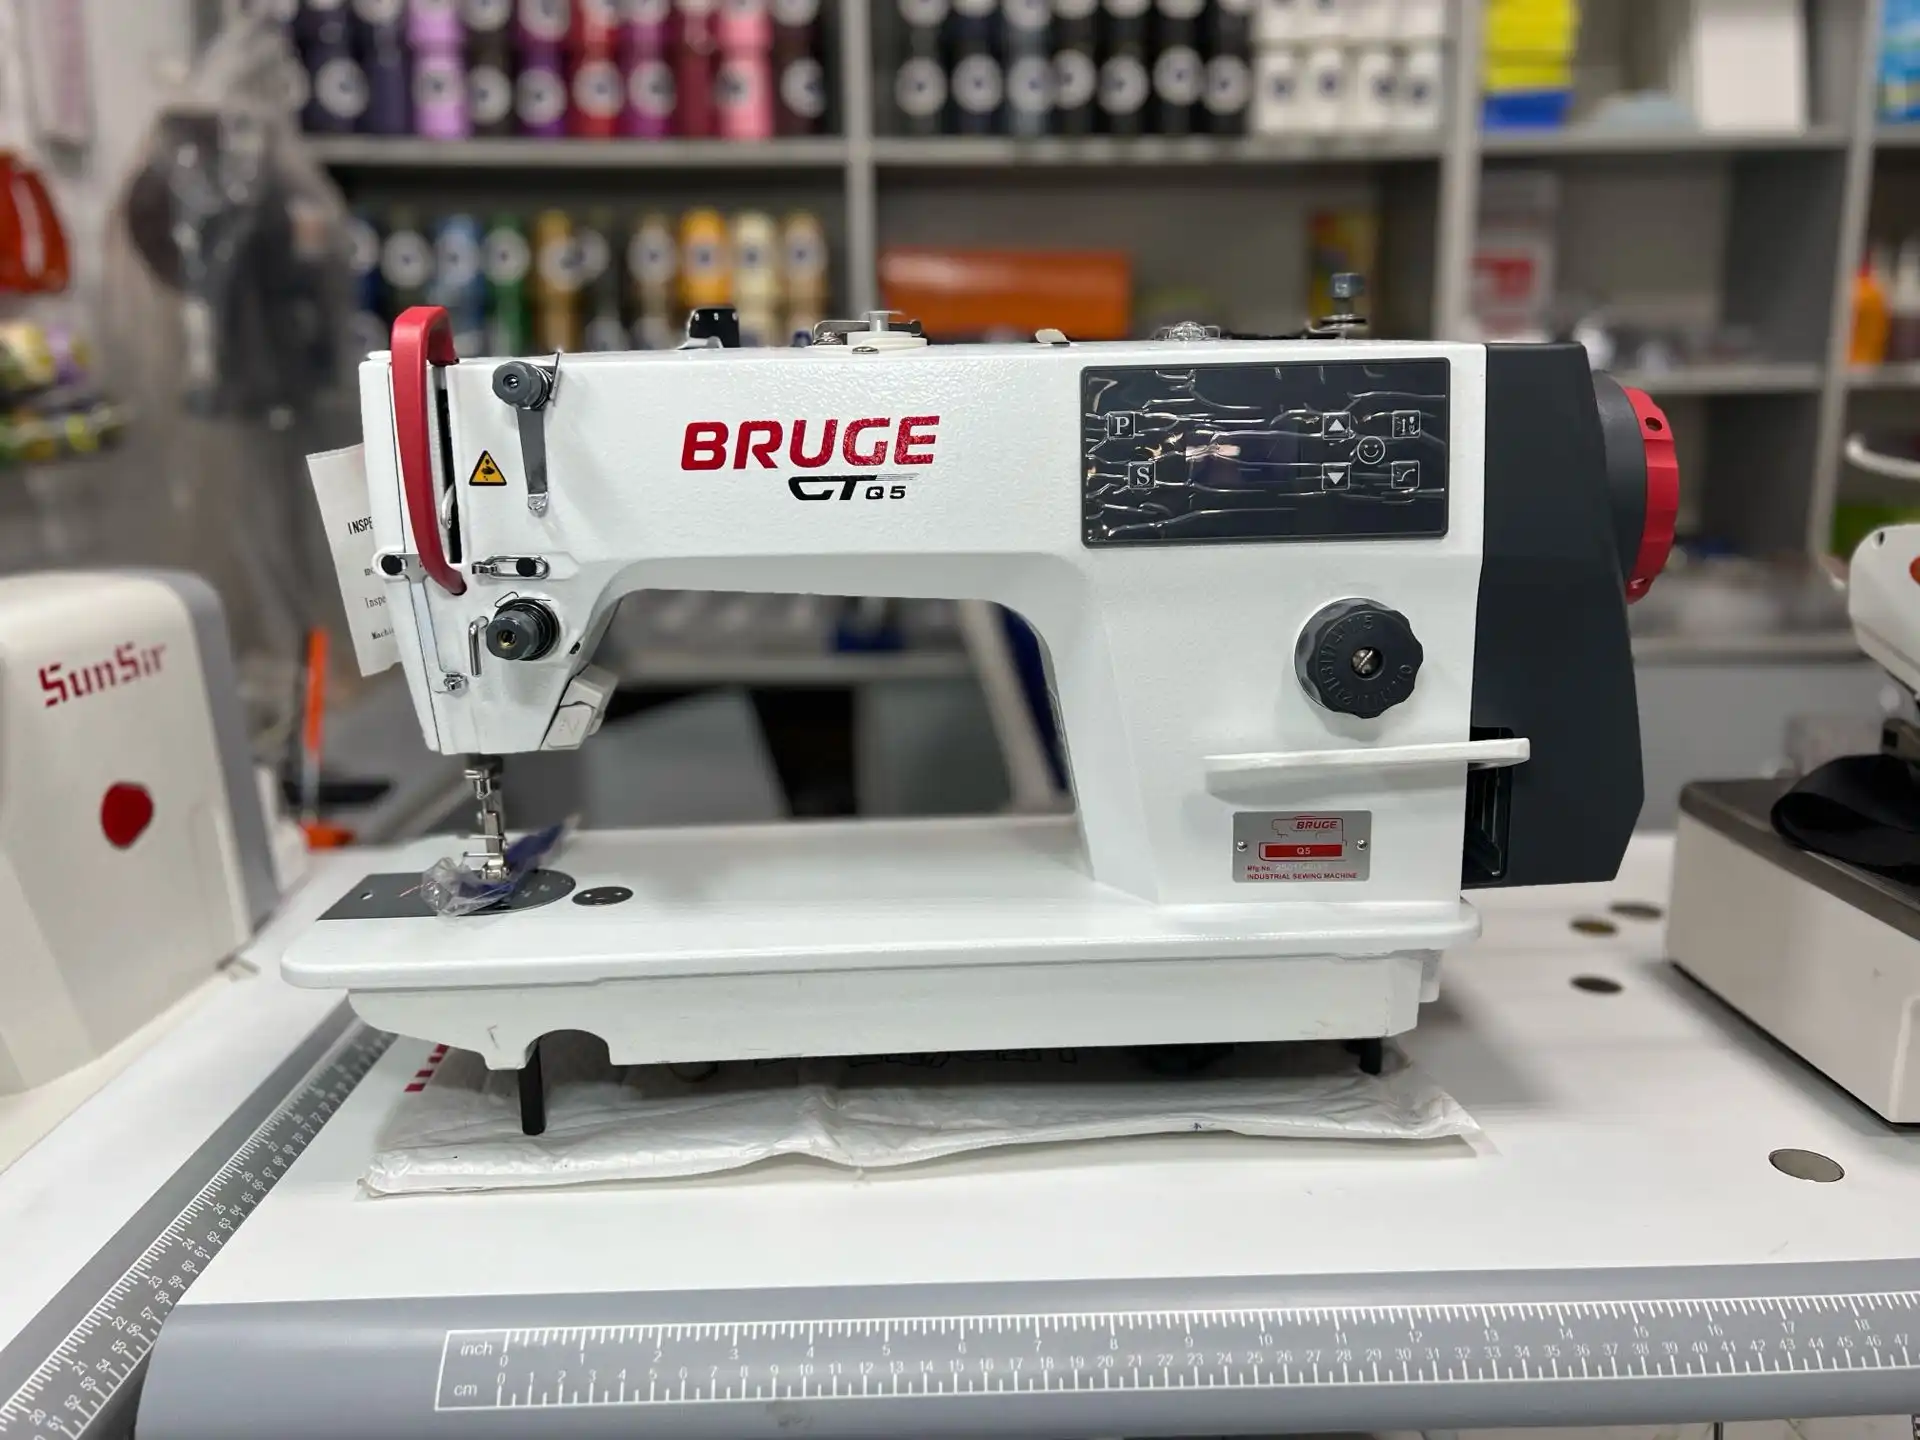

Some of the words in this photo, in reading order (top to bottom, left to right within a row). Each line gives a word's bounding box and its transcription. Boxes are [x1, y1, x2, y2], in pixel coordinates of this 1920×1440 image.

[680, 415, 941, 471] BRUGE
[1115, 417, 1130, 435] P
[1136, 467, 1151, 487] S
[39, 642, 166, 708] SunSir
[1296, 820, 1338, 830] BRUGE
[1297, 847, 1311, 855] Q5
[29, 1409, 46, 1425] 20
[72, 1361, 88, 1376] 21
[111, 1316, 128, 1330] 22
[148, 1276, 163, 1288] 23
[182, 1238, 196, 1250] 24
[213, 1203, 226, 1215] 25
[242, 1171, 254, 1182] 26
[47, 1415, 63, 1431] 51
[64, 1394, 81, 1410] 52
[80, 1376, 96, 1391] 53
[96, 1358, 111, 1373] 54
[111, 1339, 126, 1354] 55
[126, 1323, 141, 1336] 56
[141, 1306, 153, 1320] 57
[155, 1291, 169, 1303] 58
[168, 1275, 182, 1288] 59
[181, 1260, 195, 1272] 60
[194, 1246, 207, 1258] 61
[207, 1230, 220, 1243] 62
[219, 1218, 231, 1229] 63
[230, 1205, 241, 1216] 64
[454, 1384, 478, 1397] cm
[497, 1372, 506, 1385] 0
[558, 1370, 566, 1383] 2
[589, 1370, 597, 1382] 3
[618, 1368, 626, 1381] 4
[649, 1368, 657, 1380] 5
[679, 1366, 688, 1380] 6
[709, 1365, 718, 1378] 7
[740, 1365, 749, 1378] 8
[770, 1364, 779, 1377] 9
[800, 1364, 814, 1376] 10
[829, 1362, 842, 1375] 11
[859, 1362, 874, 1374] 12
[890, 1360, 904, 1374] 13
[920, 1360, 933, 1372] 14
[950, 1360, 964, 1372] 15
[980, 1358, 994, 1371] 16
[1009, 1357, 1023, 1370] 17
[1040, 1356, 1054, 1370] 18
[1070, 1356, 1084, 1368] 19
[1097, 1355, 1113, 1368] 20
[1127, 1355, 1142, 1367] 21
[1157, 1354, 1174, 1366] 22
[1187, 1353, 1204, 1365] 23
[1217, 1352, 1232, 1364] 24
[1247, 1352, 1262, 1364] 25
[1277, 1350, 1292, 1363] 26
[1306, 1350, 1320, 1363] 27
[1336, 1350, 1352, 1363] 28
[1366, 1348, 1382, 1362] 29
[1396, 1348, 1411, 1360] 30
[1425, 1348, 1440, 1360] 31
[1454, 1347, 1470, 1359] 32
[1484, 1346, 1501, 1359] 33
[1514, 1345, 1530, 1358] 34
[1544, 1344, 1560, 1357] 35
[1575, 1344, 1590, 1356] 36
[1602, 1342, 1618, 1356] 37
[1692, 1341, 1708, 1353] 40
[1721, 1340, 1736, 1352] 41
[1750, 1340, 1766, 1352] 42
[1780, 1338, 1795, 1350] 43
[1808, 1337, 1824, 1349] 44
[1837, 1336, 1853, 1348] 45
[1865, 1335, 1881, 1347] 46
[1894, 1334, 1908, 1346] 47
[460, 1341, 493, 1356] inch
[500, 1355, 508, 1367] 0
[580, 1353, 585, 1367] 1
[653, 1351, 662, 1362] 2
[729, 1348, 739, 1360] 3
[806, 1346, 814, 1358] 4
[882, 1344, 890, 1356] 5
[958, 1341, 967, 1354] 6
[1034, 1340, 1042, 1352] 7
[1110, 1338, 1118, 1350] 8
[1184, 1336, 1194, 1348] 9
[1258, 1334, 1273, 1346] 10
[1335, 1332, 1348, 1344] 11
[1484, 1330, 1499, 1342] 13
[1560, 1328, 1574, 1340] 14
[1708, 1324, 1722, 1337] 16
[1781, 1321, 1795, 1334] 17
[1855, 1319, 1870, 1332] 18
